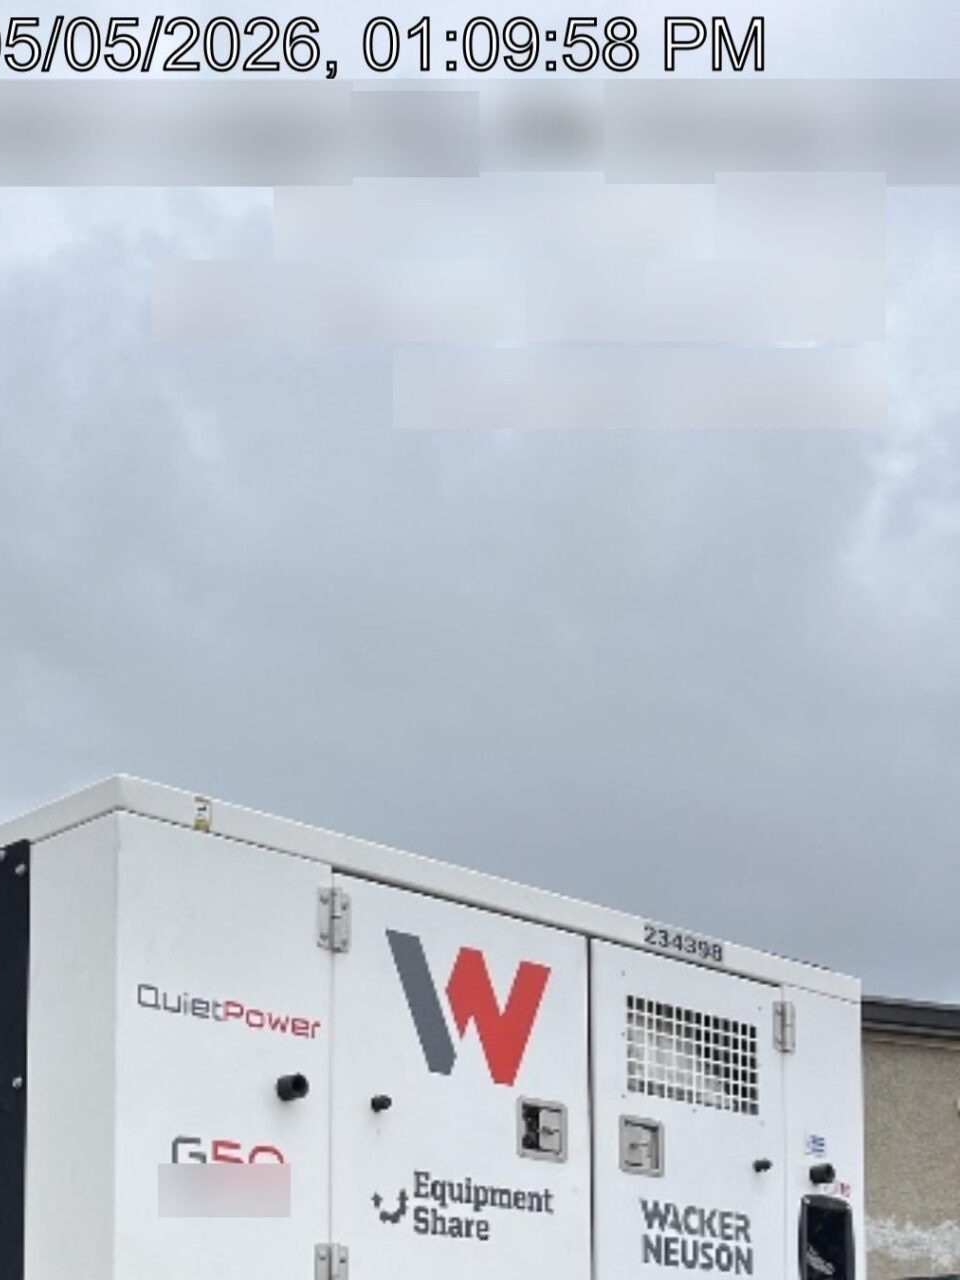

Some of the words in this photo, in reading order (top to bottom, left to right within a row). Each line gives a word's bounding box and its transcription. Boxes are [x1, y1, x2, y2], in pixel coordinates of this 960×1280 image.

[643, 925, 723, 962] 234398
[137, 983, 321, 1039] QuietPower
[413, 1170, 555, 1215] Equipment
[413, 1206, 489, 1241] Share
[639, 1198, 752, 1243] WACKER
[642, 1234, 753, 1275] NEUSON
